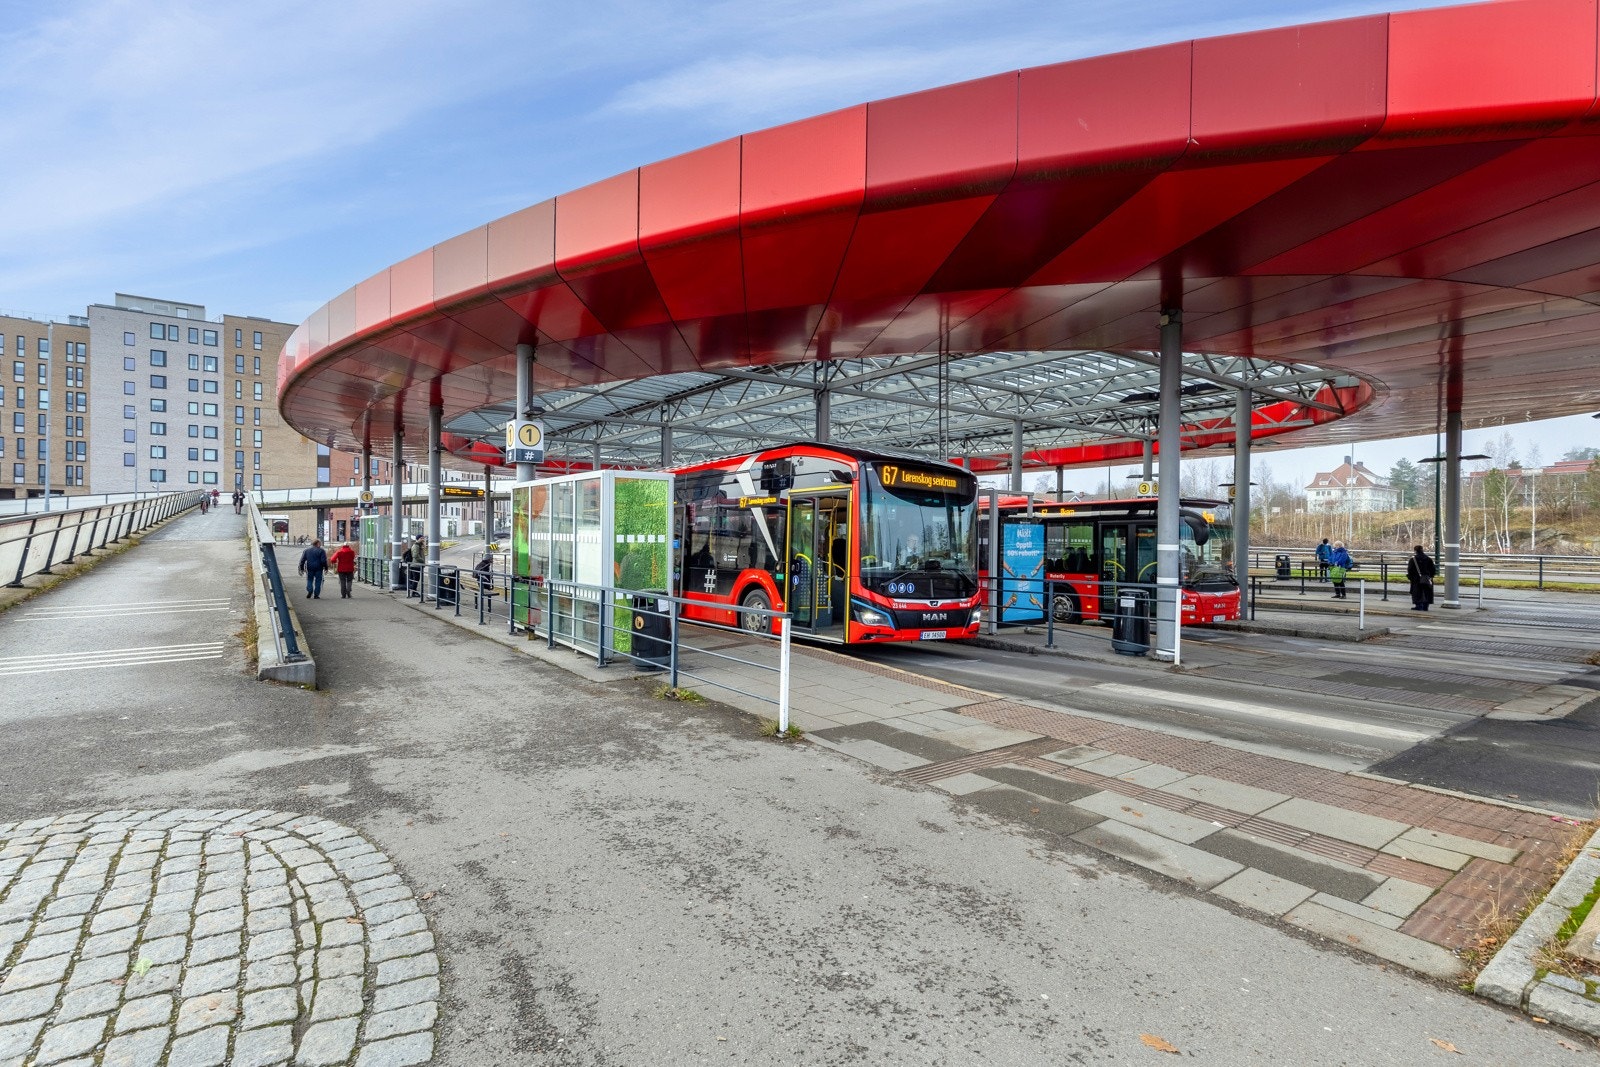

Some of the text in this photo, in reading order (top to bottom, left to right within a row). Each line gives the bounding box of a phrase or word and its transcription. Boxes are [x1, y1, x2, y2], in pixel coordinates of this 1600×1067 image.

[526, 428, 532, 442] 1
[525, 451, 534, 460] #
[883, 465, 957, 488] 67 Lørenskog sentrum
[1141, 484, 1147, 492] 3
[739, 496, 748, 508] 67
[922, 613, 947, 621] MAN
